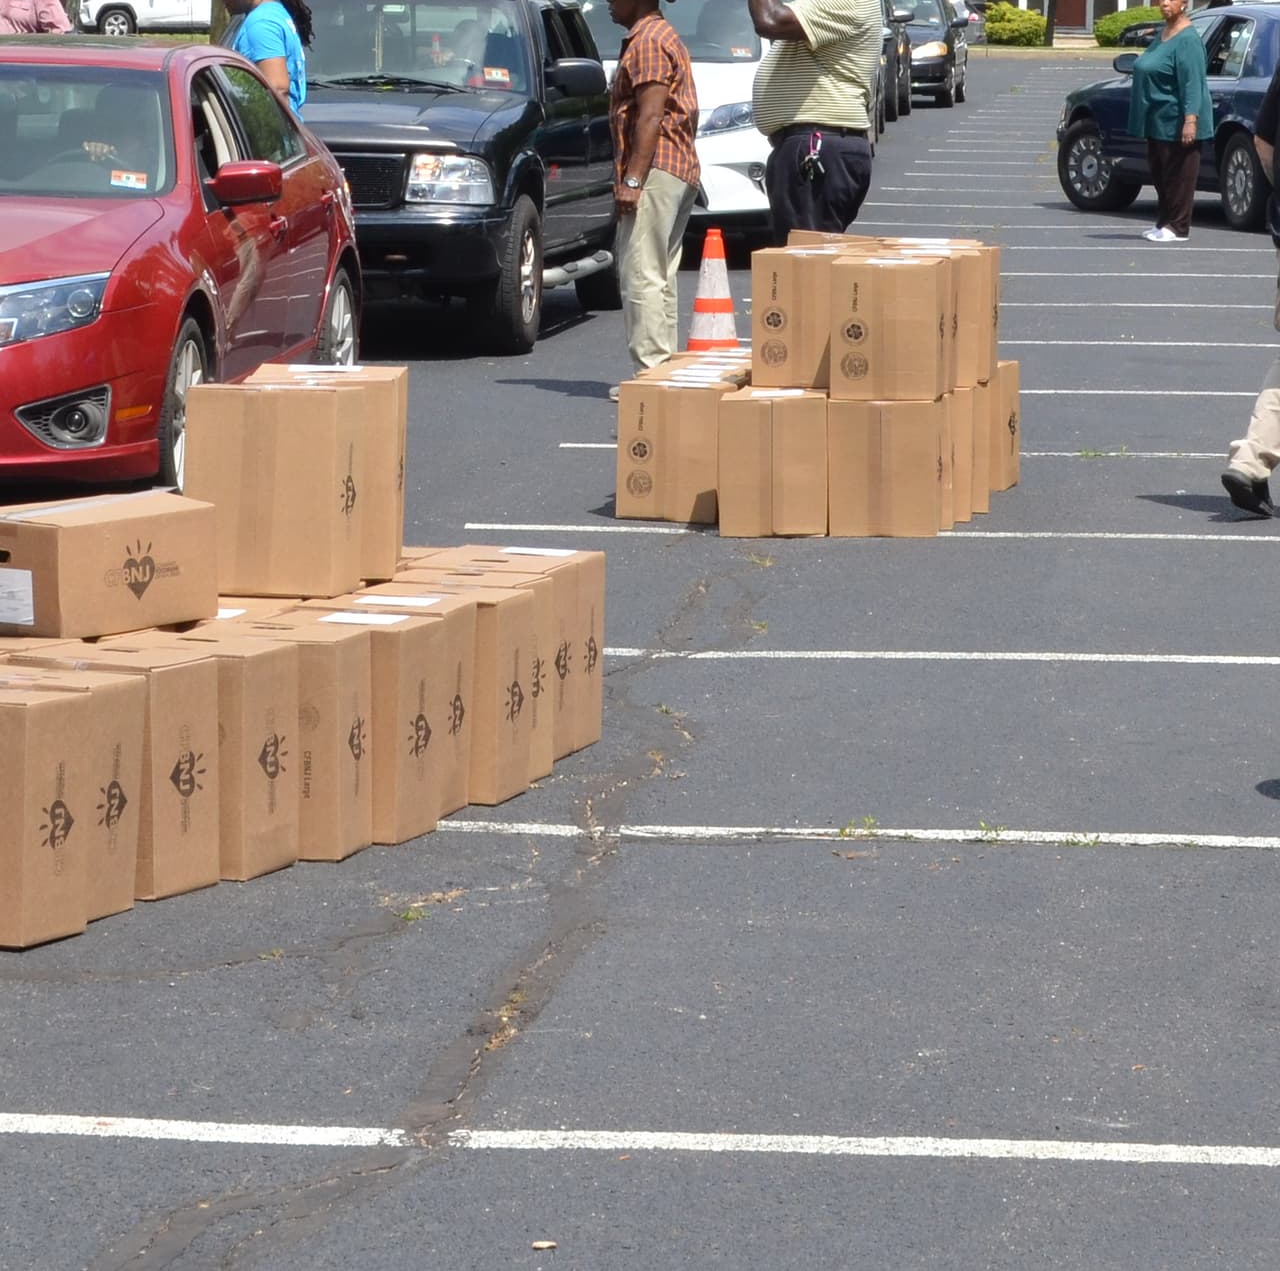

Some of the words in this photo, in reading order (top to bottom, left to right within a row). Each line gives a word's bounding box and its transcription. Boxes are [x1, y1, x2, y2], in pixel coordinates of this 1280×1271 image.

[180, 723, 191, 790] BNJ
[304, 750, 312, 776] CFBNJ
[302, 777, 312, 800] Large
[54, 807, 65, 877] BNJ
